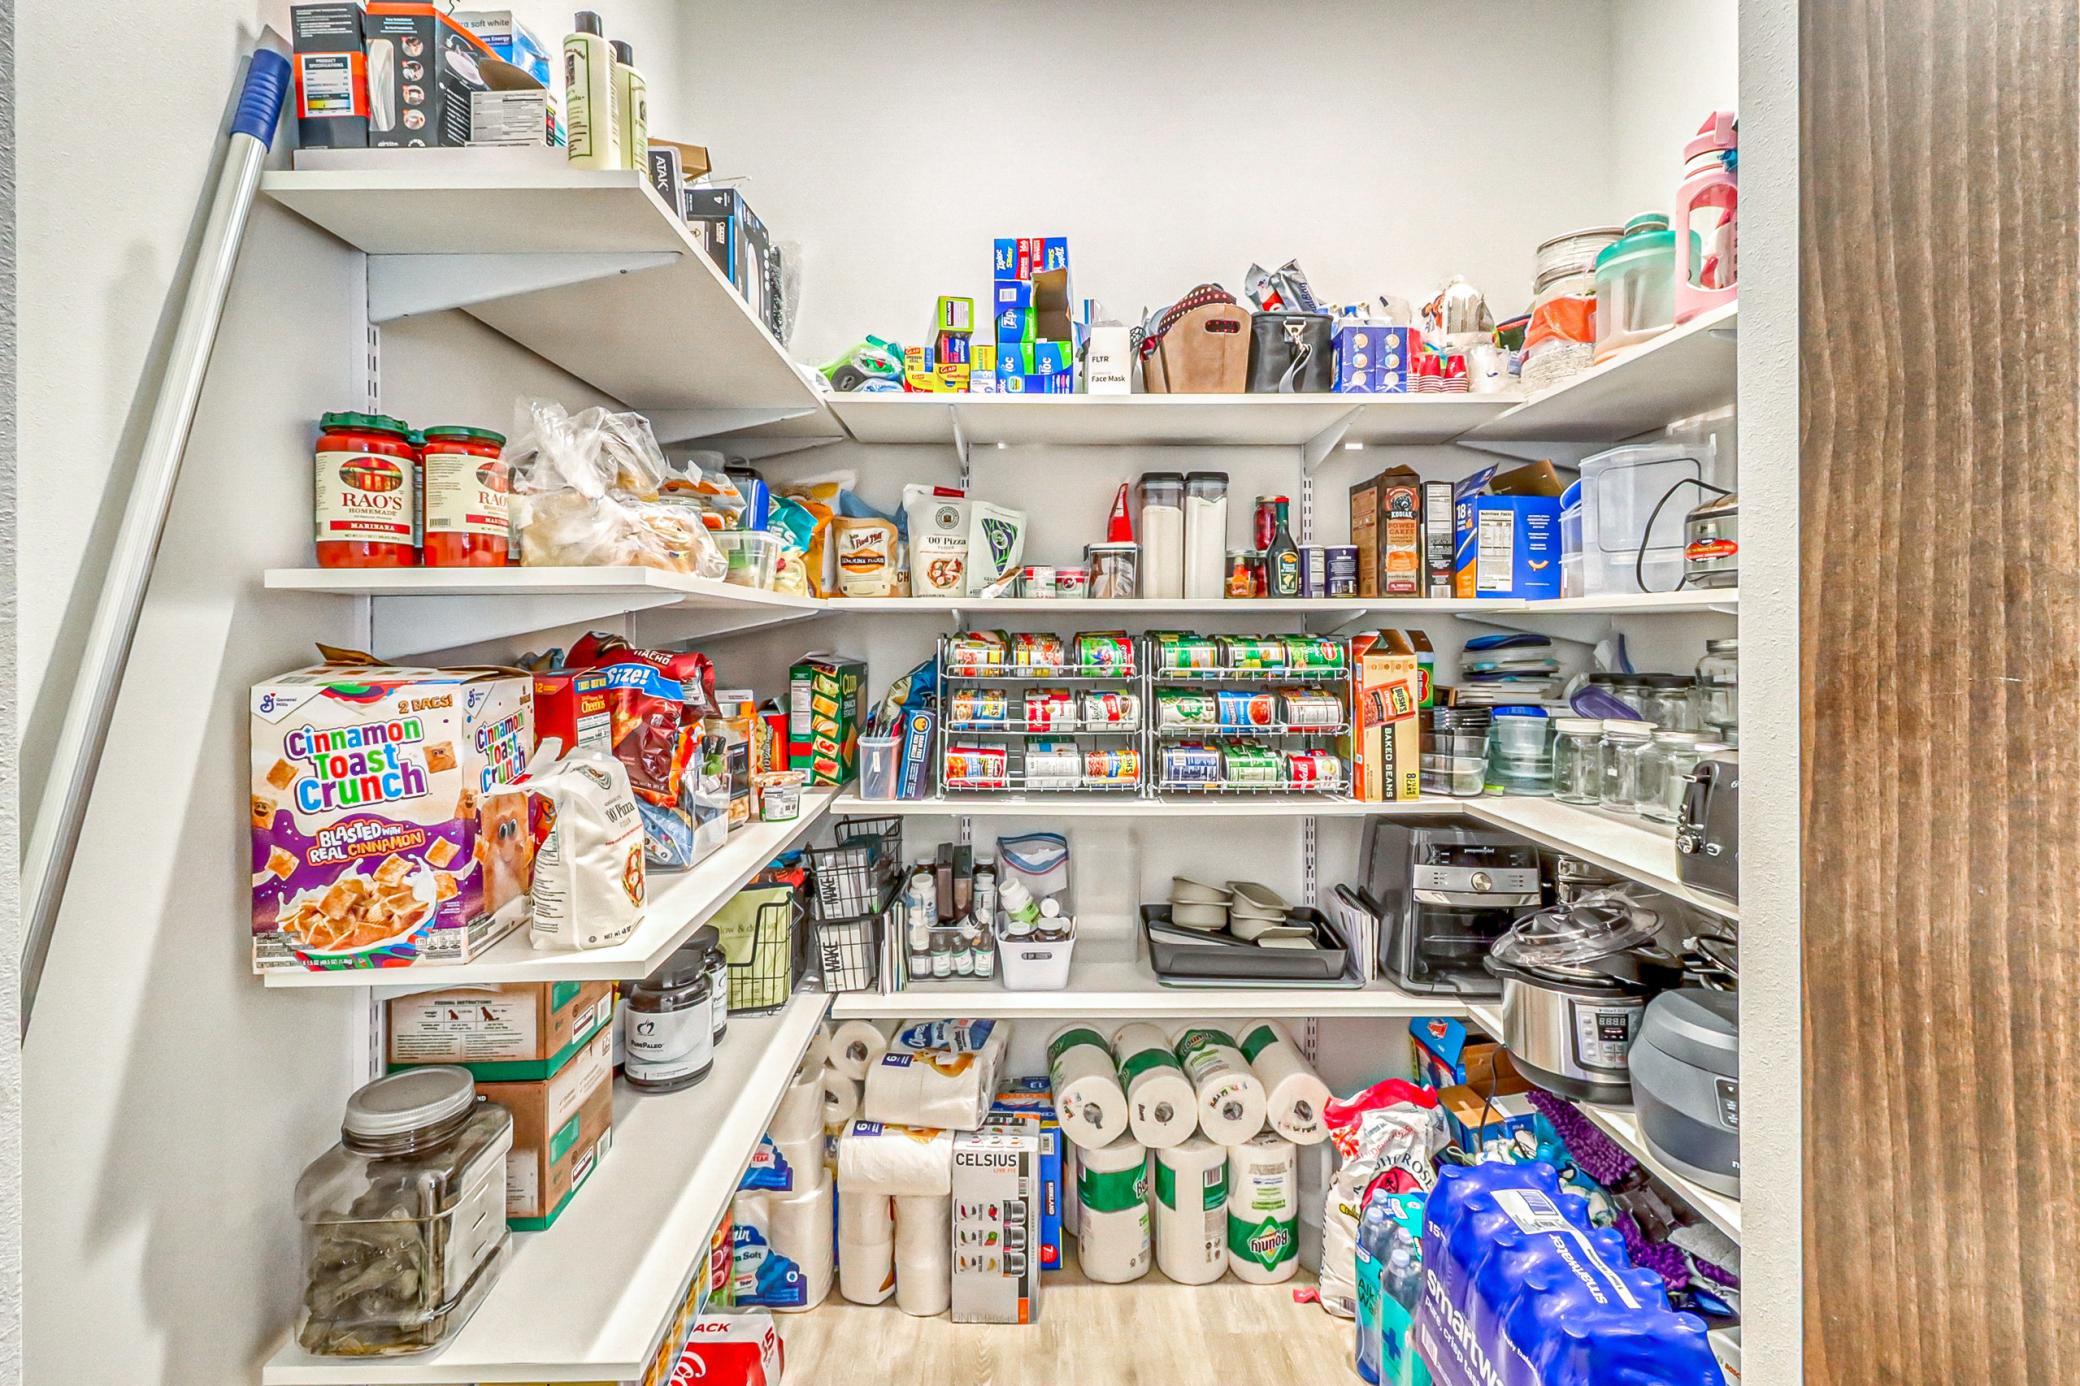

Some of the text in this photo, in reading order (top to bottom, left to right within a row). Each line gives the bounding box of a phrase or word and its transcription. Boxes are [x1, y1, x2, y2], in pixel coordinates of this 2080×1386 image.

[471, 20, 486, 28] soft
[487, 19, 510, 27] white
[655, 155, 669, 191] ATAK
[996, 249, 1006, 270] Ziploc
[940, 364, 957, 373] GLAD
[341, 492, 403, 511] RAO'S
[348, 508, 397, 516] HOMEMADE
[1456, 503, 1467, 519] 18
[350, 522, 396, 531] MARINARA
[1390, 510, 1413, 519] KODIAK
[943, 537, 967, 546] Pizza
[535, 682, 543, 693] 12
[606, 667, 651, 685] Size!
[398, 702, 409, 714] 2
[1393, 686, 1409, 715] BUSH'S
[288, 717, 422, 758] Cinnamon
[477, 710, 524, 751] Cinnamon
[487, 731, 518, 767] Toast
[1383, 727, 1393, 762] BAKED
[313, 743, 399, 780] Toast
[481, 745, 526, 793] Crunch
[297, 762, 427, 812] Crunch
[1384, 764, 1394, 799] BEANS
[616, 801, 636, 816] Pizza
[309, 832, 422, 863] REAL CINNAMON
[320, 822, 382, 848] BLASTED
[822, 940, 841, 973] MAKE
[955, 1152, 1017, 1167] CELSIUS
[1251, 1228, 1289, 1253] Bounty
[1549, 1233, 1609, 1305] smartwater
